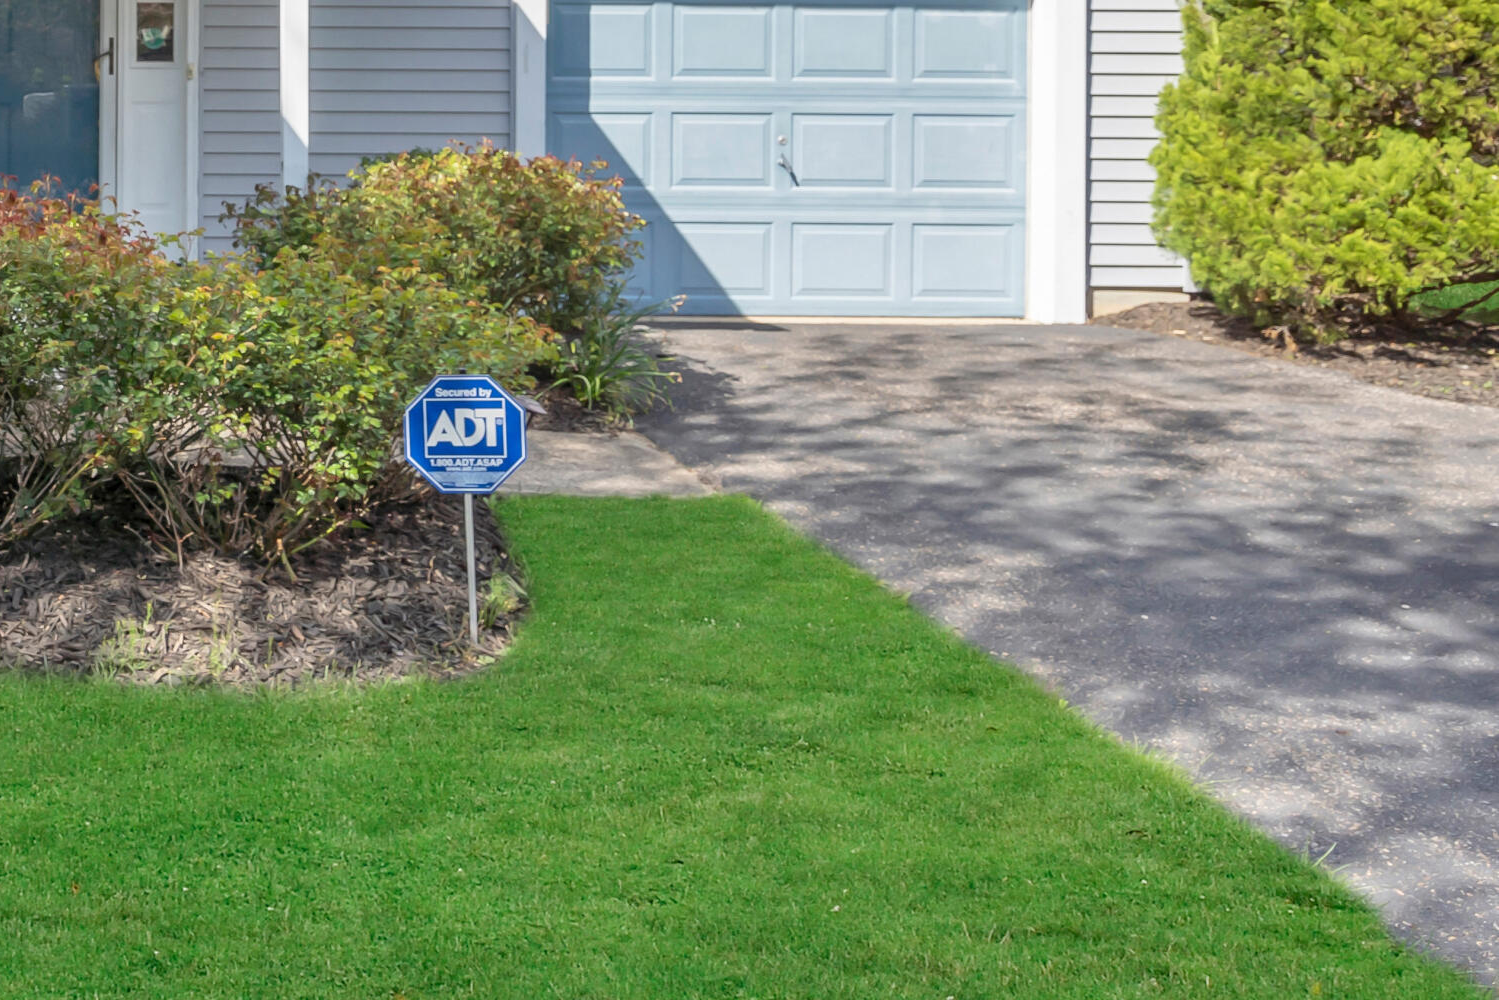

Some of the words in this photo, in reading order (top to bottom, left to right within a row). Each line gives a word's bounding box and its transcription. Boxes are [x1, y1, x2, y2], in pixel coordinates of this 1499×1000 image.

[435, 388, 476, 397] Secured
[479, 388, 492, 398] by
[426, 408, 504, 447] ADT
